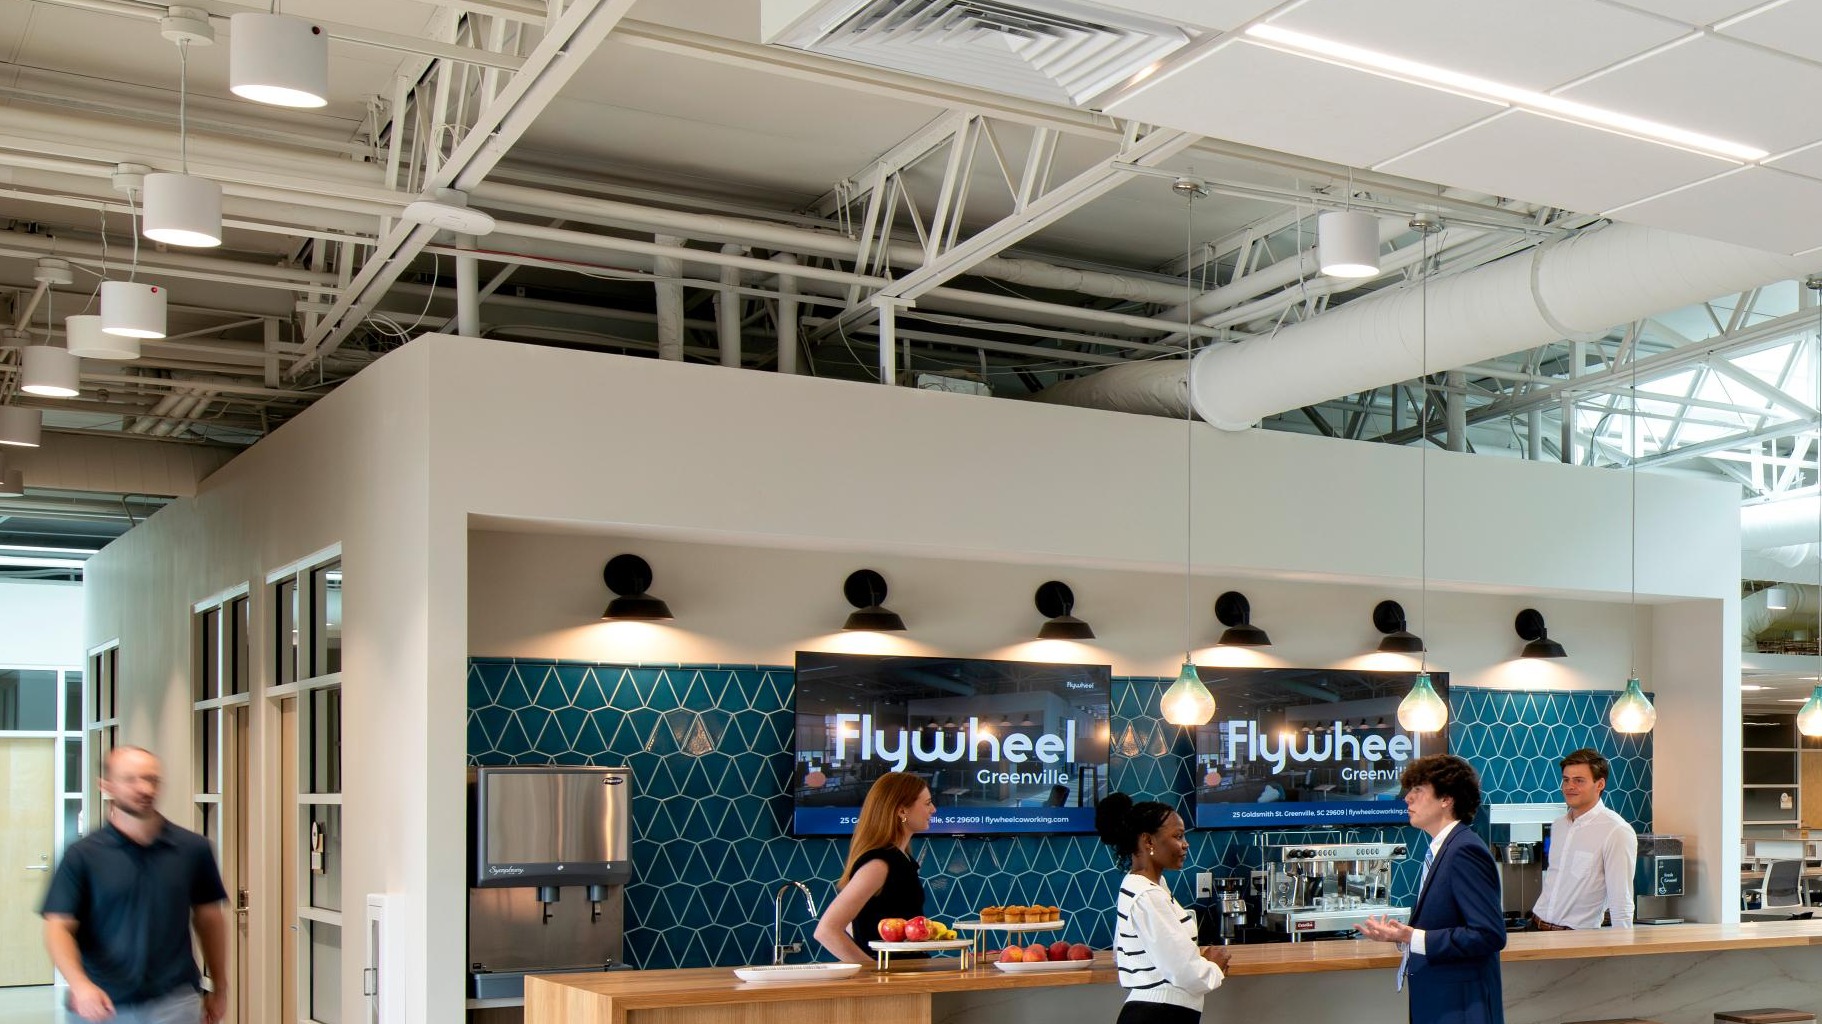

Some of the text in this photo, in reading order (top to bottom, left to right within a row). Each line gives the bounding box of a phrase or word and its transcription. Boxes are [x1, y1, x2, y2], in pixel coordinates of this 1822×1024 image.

[835, 713, 1075, 772] Flywheel
[1228, 720, 1420, 774] Flywheel
[977, 769, 1069, 785] Greenville
[1341, 767, 1407, 781] Greenvi
[1326, 809, 1345, 817] 29609
[1349, 808, 1409, 817] flywheelcoworking.c
[840, 816, 850, 824] 25
[945, 816, 956, 824] SC
[957, 816, 980, 824] 29609
[986, 815, 1069, 826] flywheelcoworking.com
